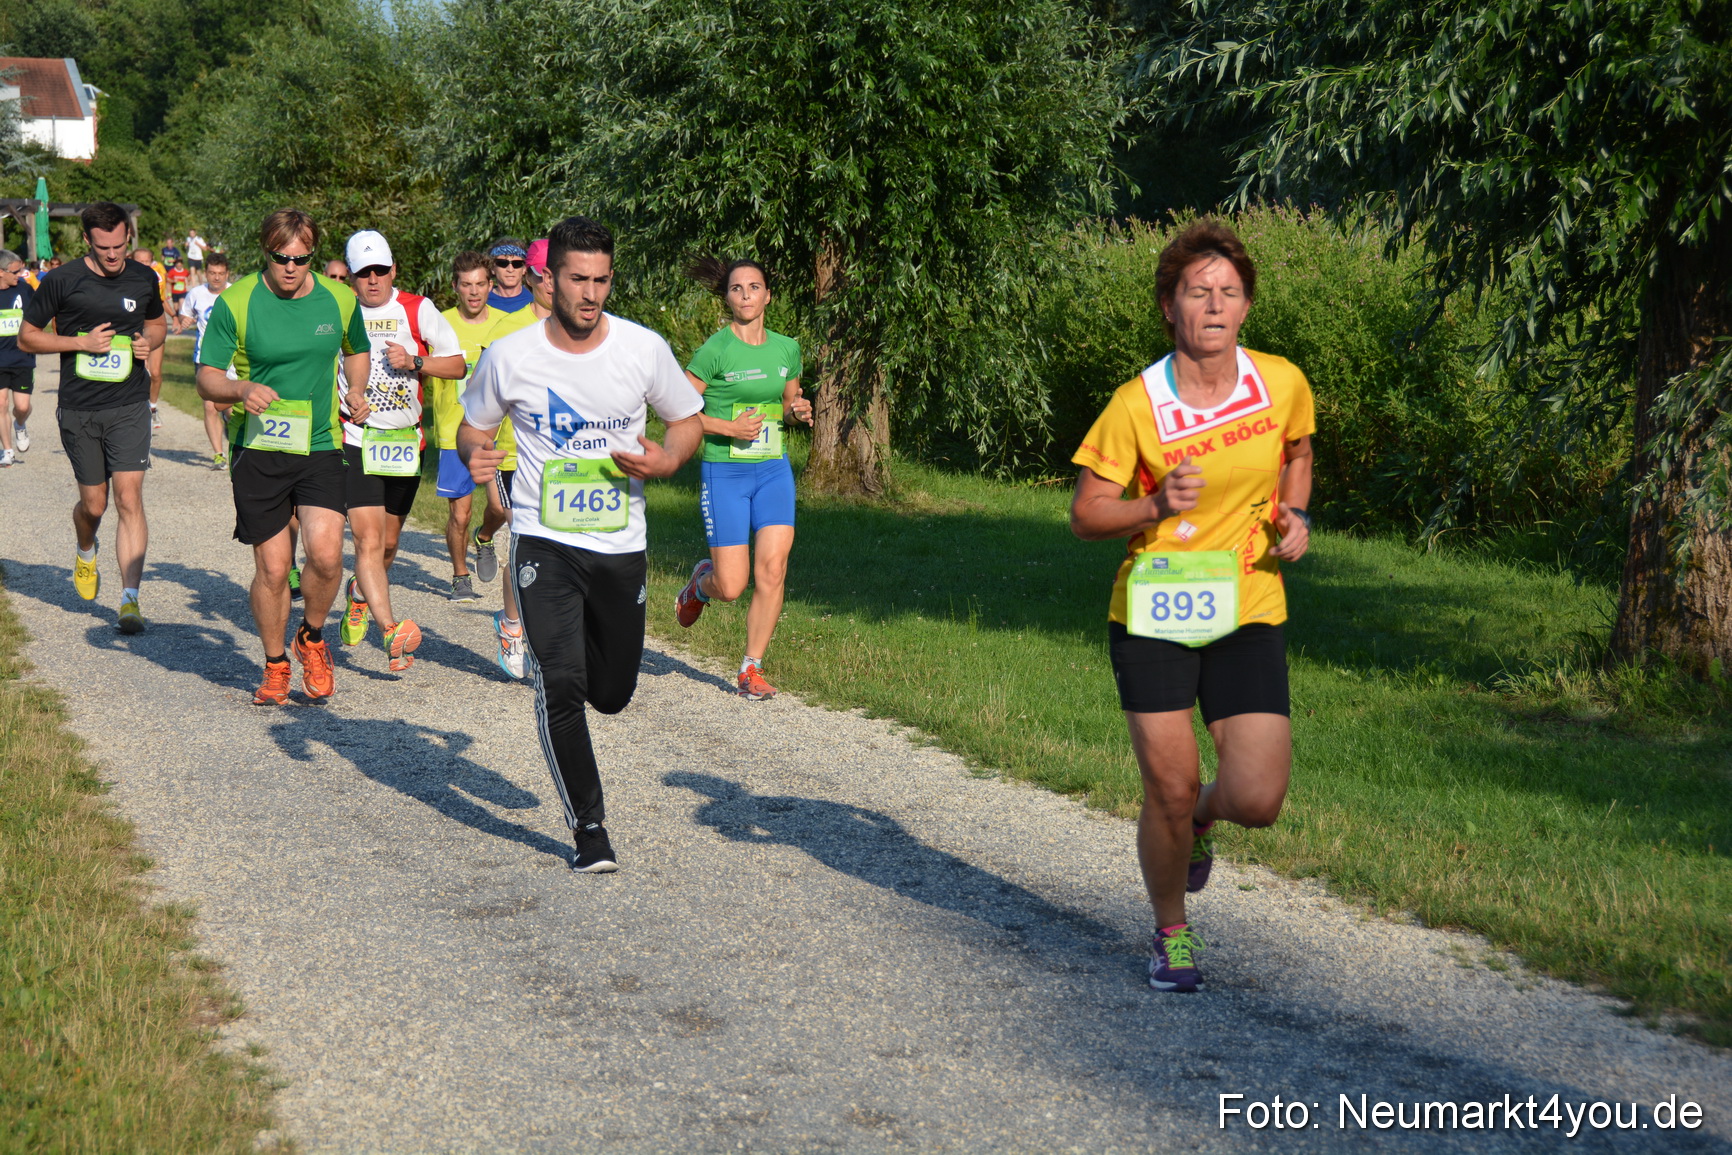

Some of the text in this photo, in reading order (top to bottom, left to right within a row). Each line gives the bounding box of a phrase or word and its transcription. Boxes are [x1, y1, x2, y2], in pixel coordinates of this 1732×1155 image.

[368, 331, 398, 339] Germany
[87, 352, 122, 369] 329
[264, 419, 291, 439] 22
[750, 426, 769, 443] 1
[1161, 416, 1279, 467] MAX BÖGL
[368, 444, 415, 463] 1026
[553, 487, 622, 513] 1463
[701, 482, 714, 538] skinfit
[1144, 567, 1183, 577] firmenlauf
[1150, 590, 1217, 622] 893
